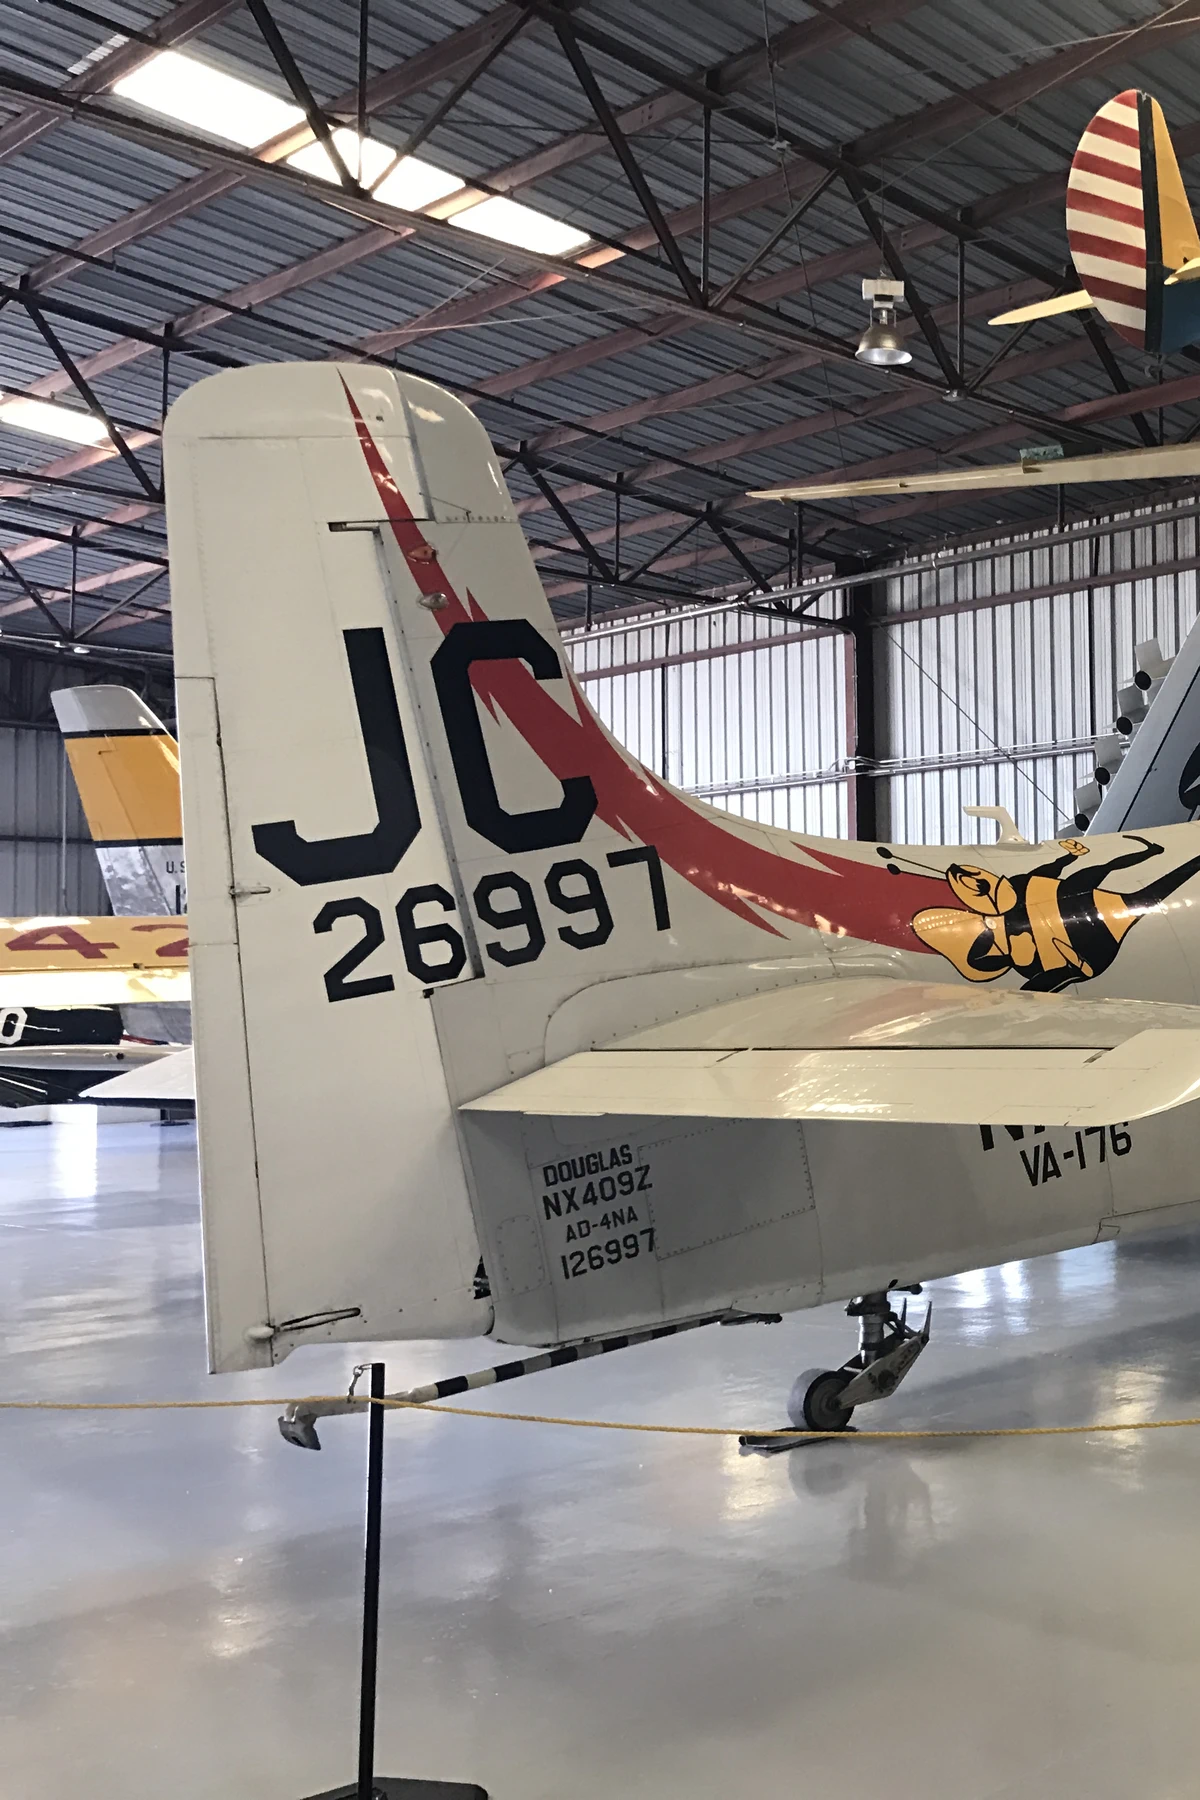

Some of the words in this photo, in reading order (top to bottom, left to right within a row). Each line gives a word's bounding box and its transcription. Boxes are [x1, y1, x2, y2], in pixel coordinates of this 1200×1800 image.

[252, 619, 599, 887] JC
[313, 846, 671, 1003] 26997
[542, 1144, 633, 1187] DOUGLAS
[1020, 1121, 1132, 1187] VA-176
[542, 1165, 653, 1220] NX409Z
[565, 1206, 638, 1243] AD-4NA
[561, 1228, 657, 1280] 126997
